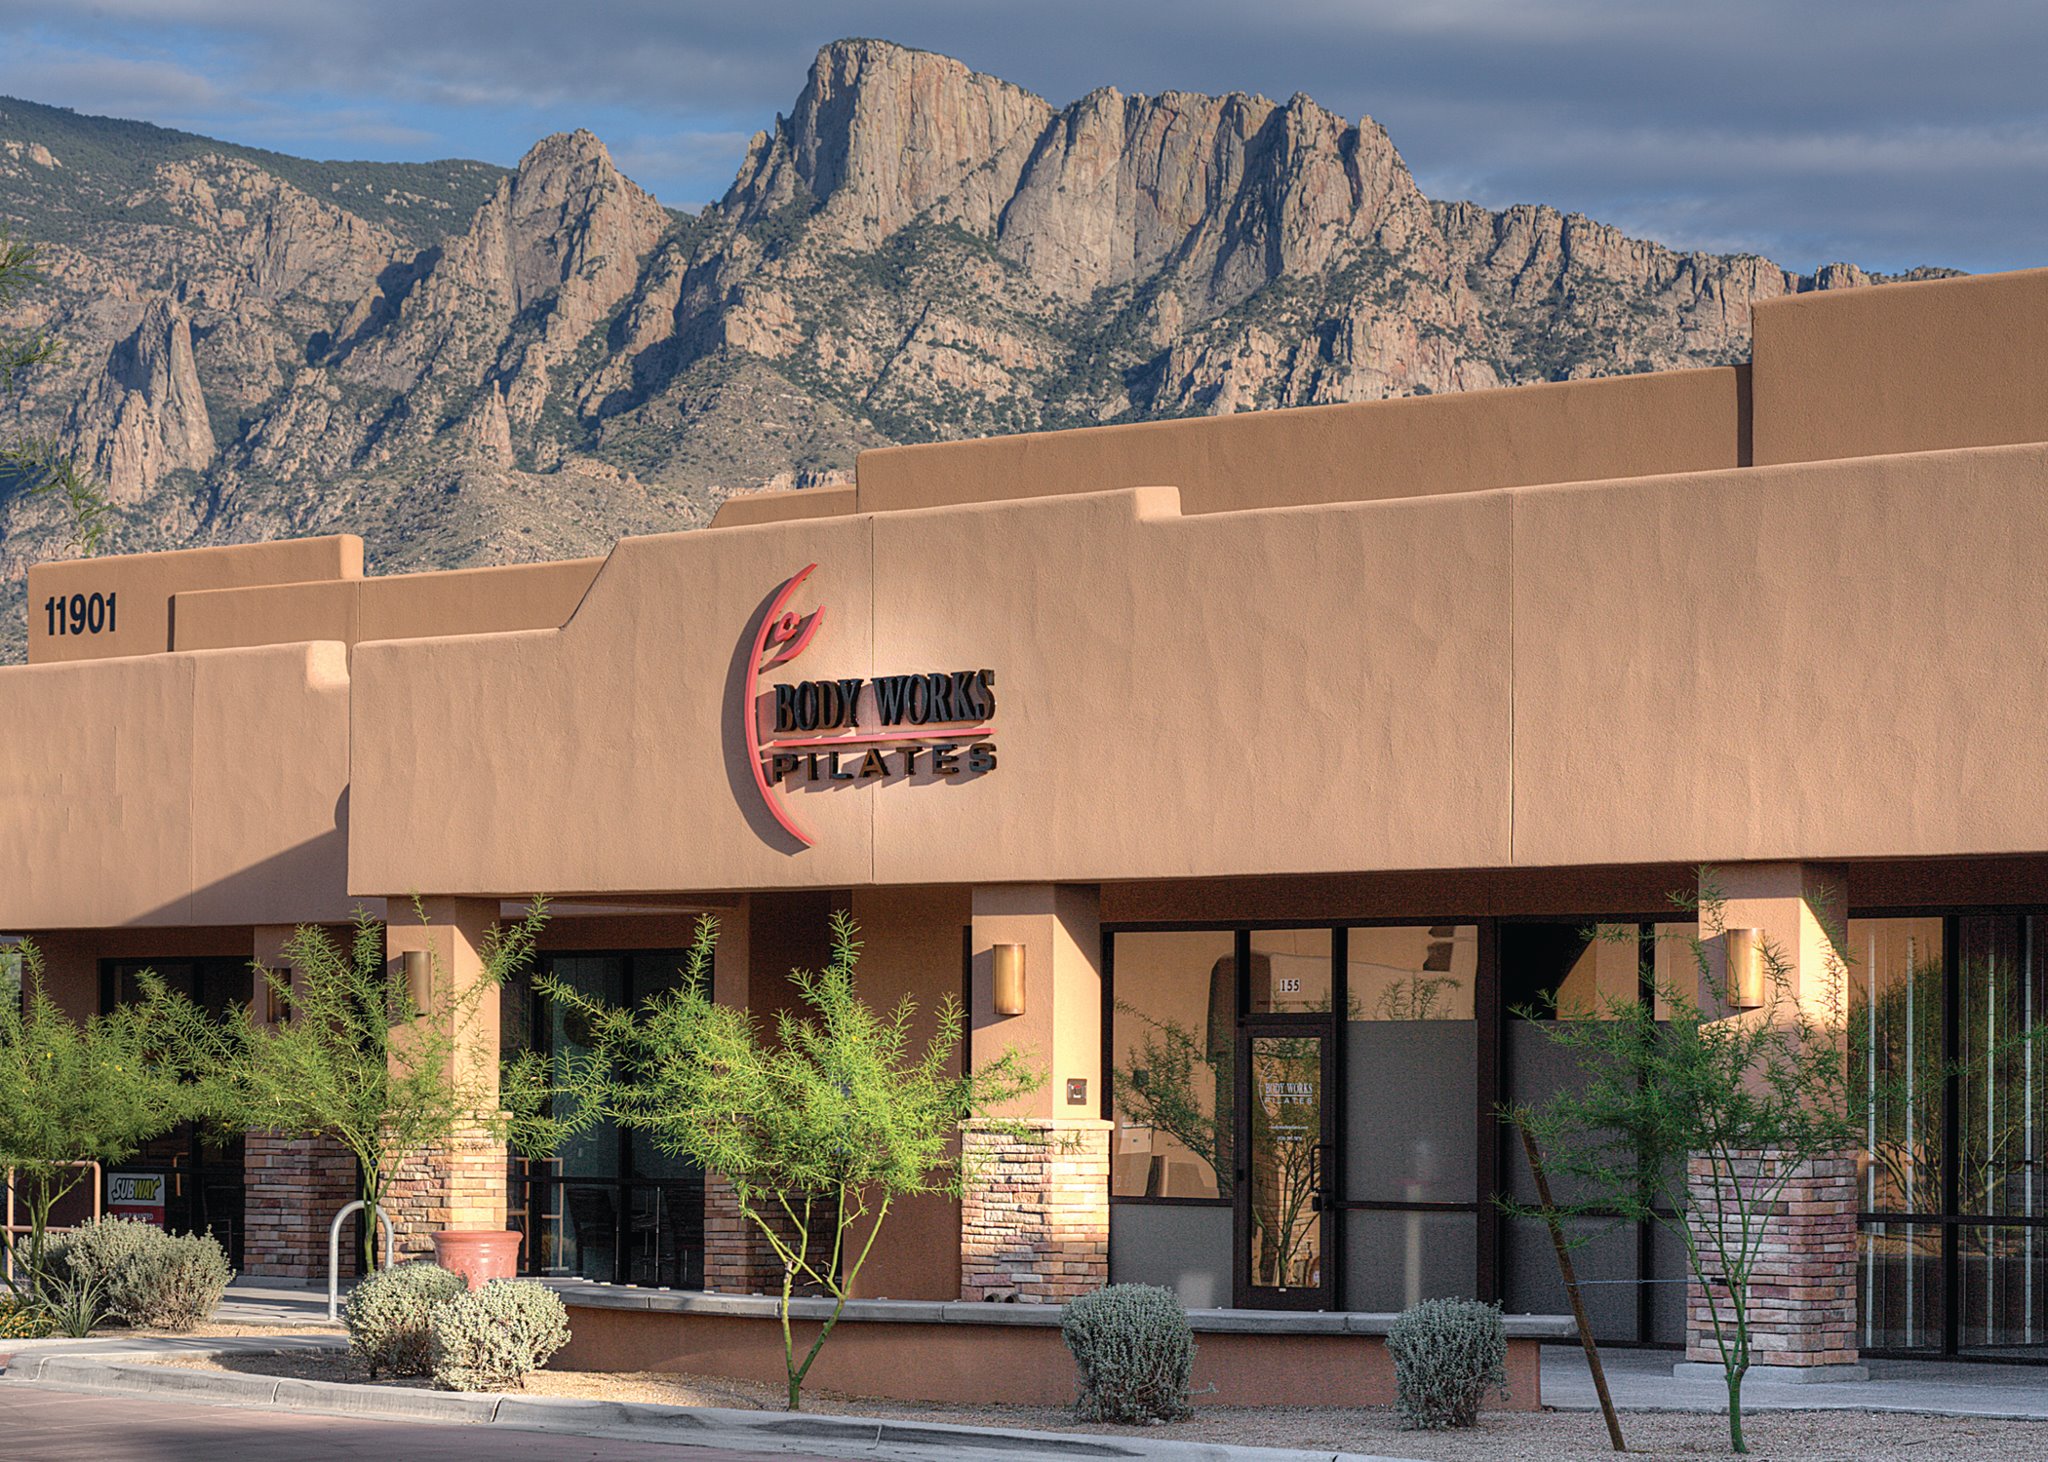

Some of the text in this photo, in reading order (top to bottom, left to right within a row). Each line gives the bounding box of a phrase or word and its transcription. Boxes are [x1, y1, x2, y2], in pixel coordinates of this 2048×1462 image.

[45, 592, 116, 636] 11901
[773, 669, 996, 732] BODY WORKS
[772, 743, 997, 782] PILATES
[1281, 979, 1300, 992] 155
[1286, 1082, 1313, 1094] WORKS
[111, 1176, 162, 1202] SUBWAY
